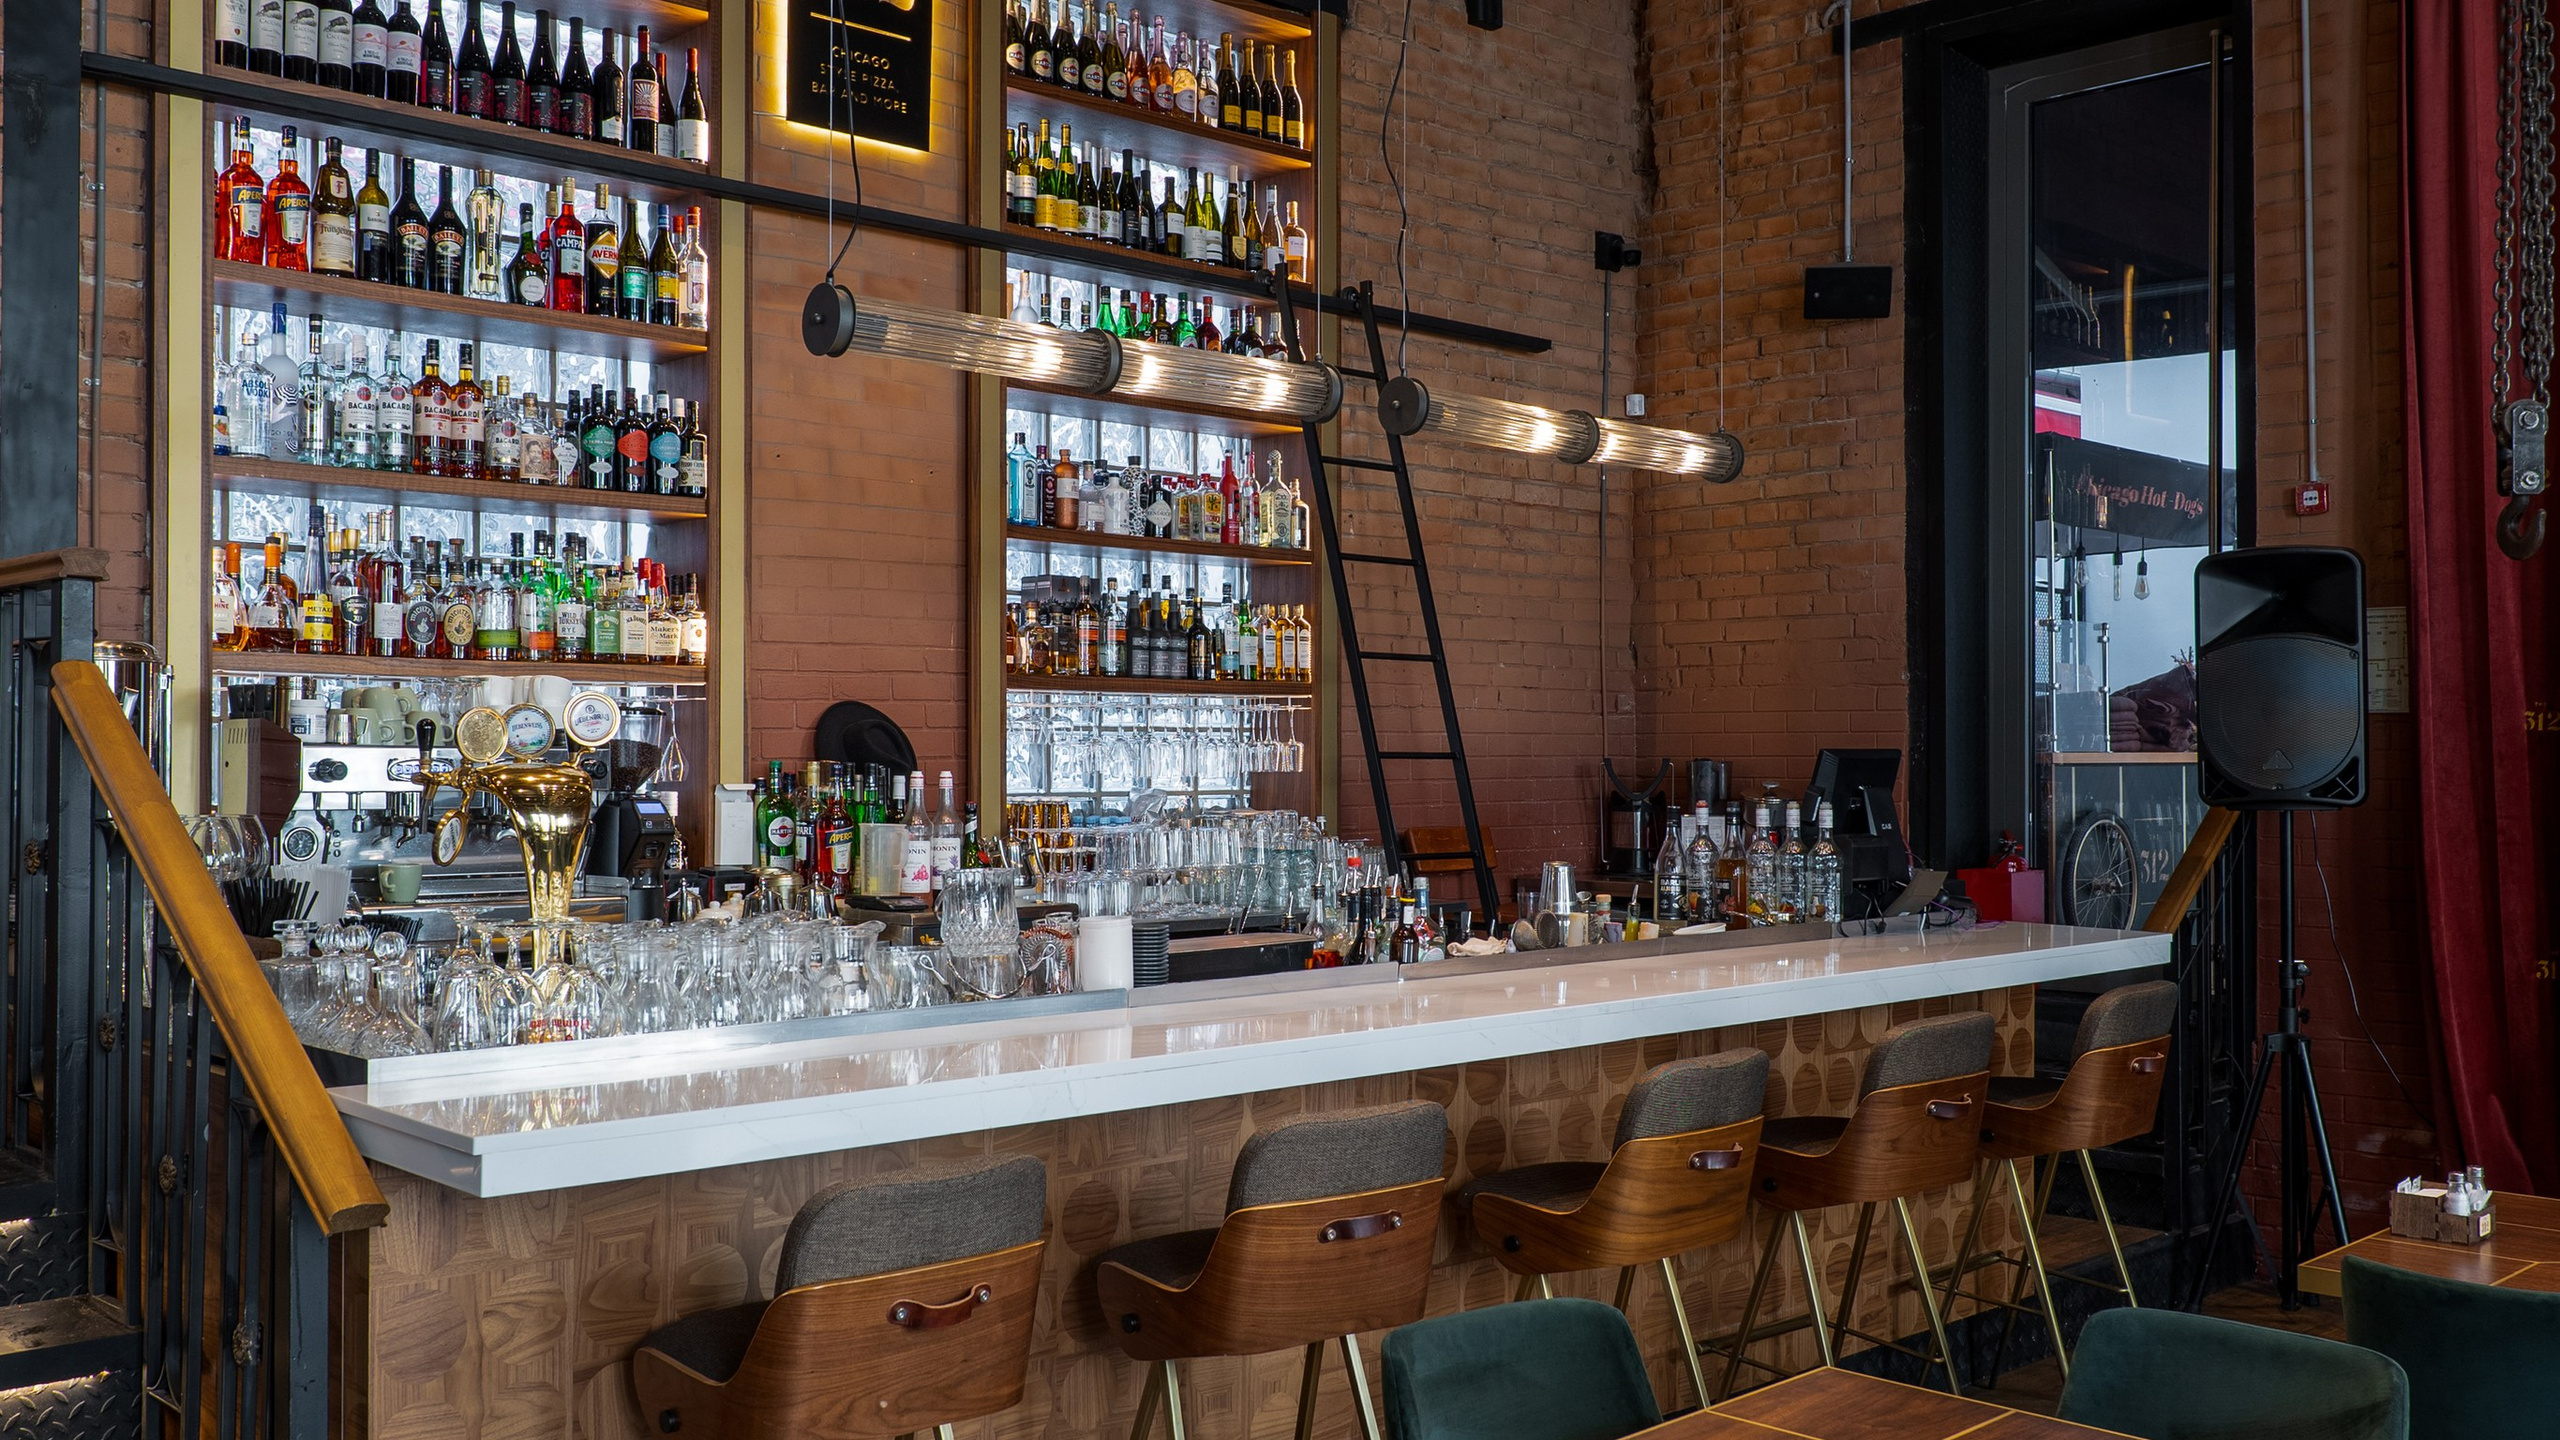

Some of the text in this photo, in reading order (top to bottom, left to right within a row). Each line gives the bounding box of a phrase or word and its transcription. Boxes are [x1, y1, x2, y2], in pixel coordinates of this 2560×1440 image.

[831, 46, 890, 70] CHICAGO
[873, 96, 907, 114] MORE
[2140, 485, 2168, 509] Hot
[561, 626, 576, 634] RYE
[2140, 848, 2170, 884] 312
